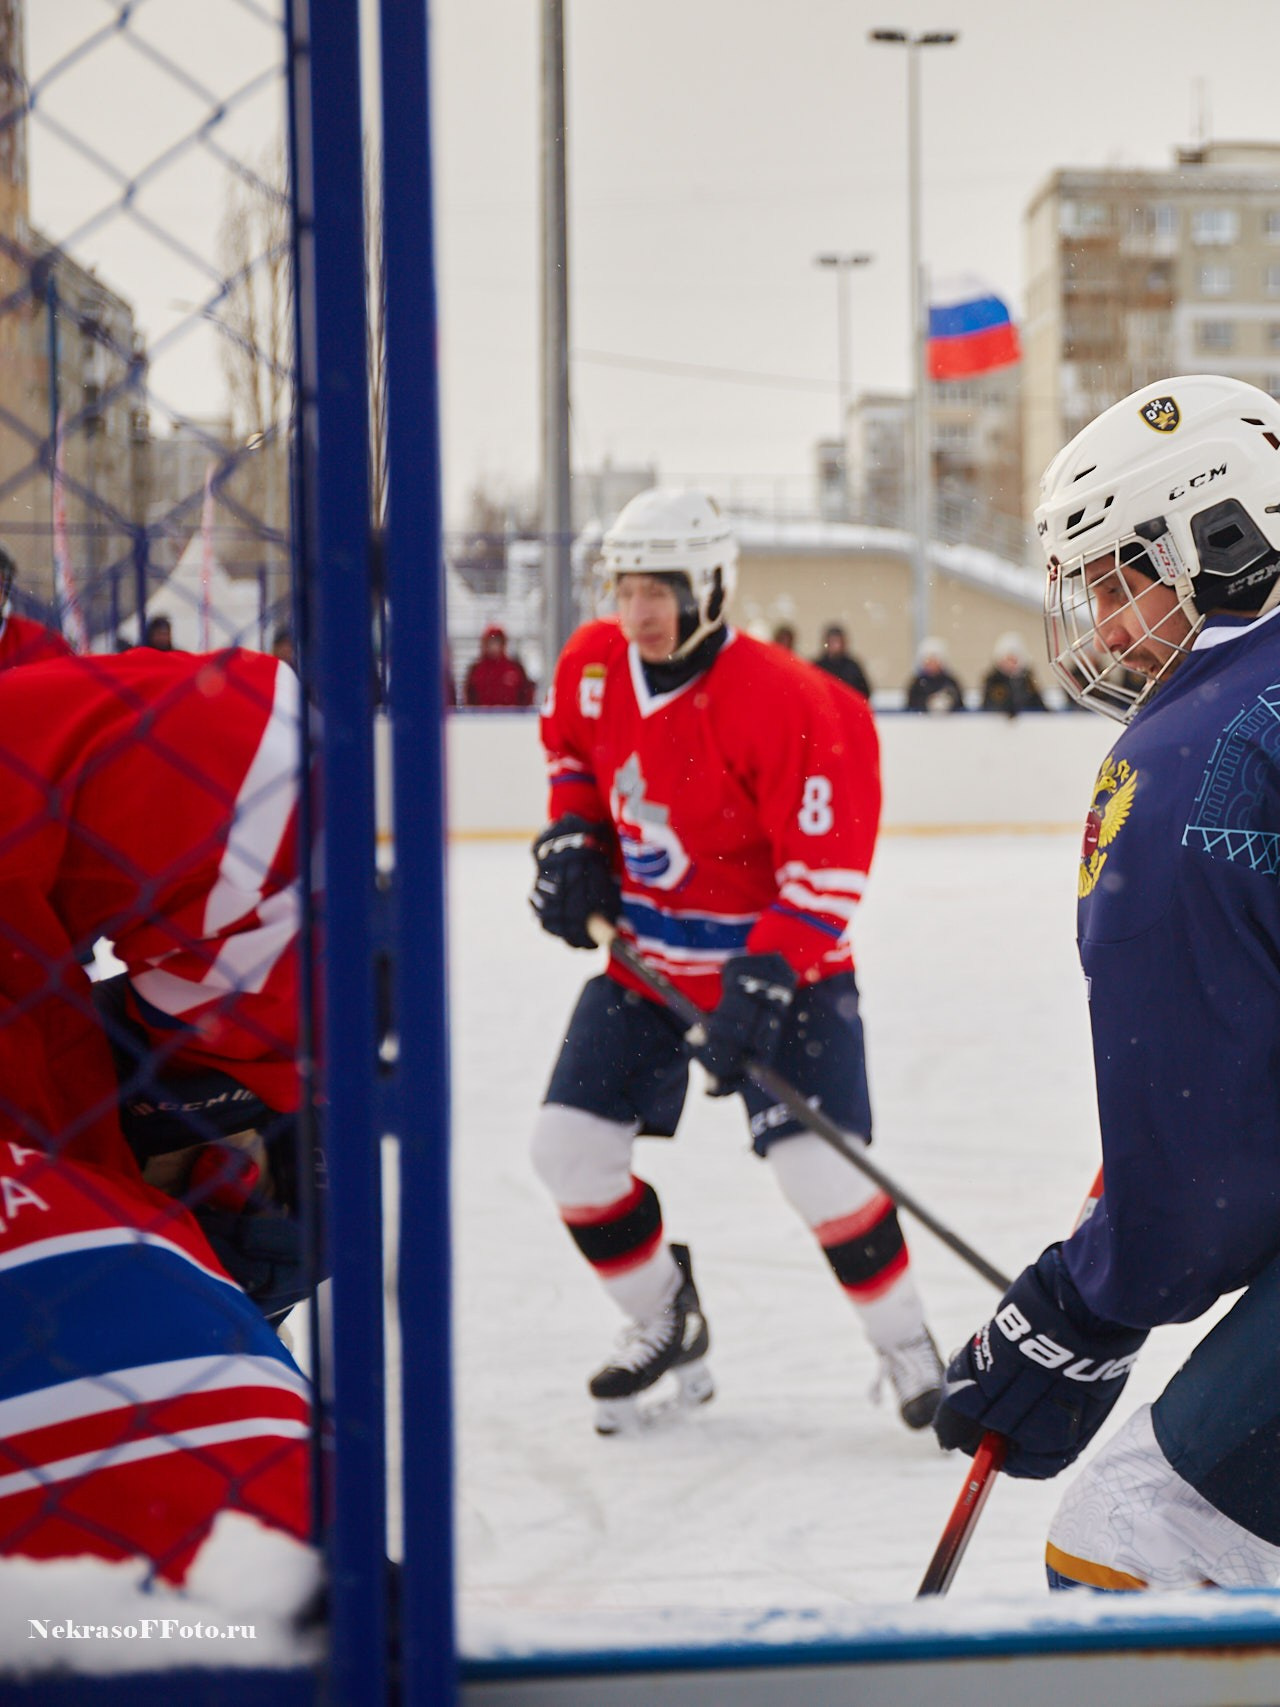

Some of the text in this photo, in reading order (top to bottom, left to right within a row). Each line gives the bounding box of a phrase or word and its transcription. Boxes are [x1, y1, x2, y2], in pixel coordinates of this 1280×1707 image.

[1168, 462, 1228, 501] CCM
[797, 774, 835, 837] 8
[995, 1302, 1138, 1382] BAUE
